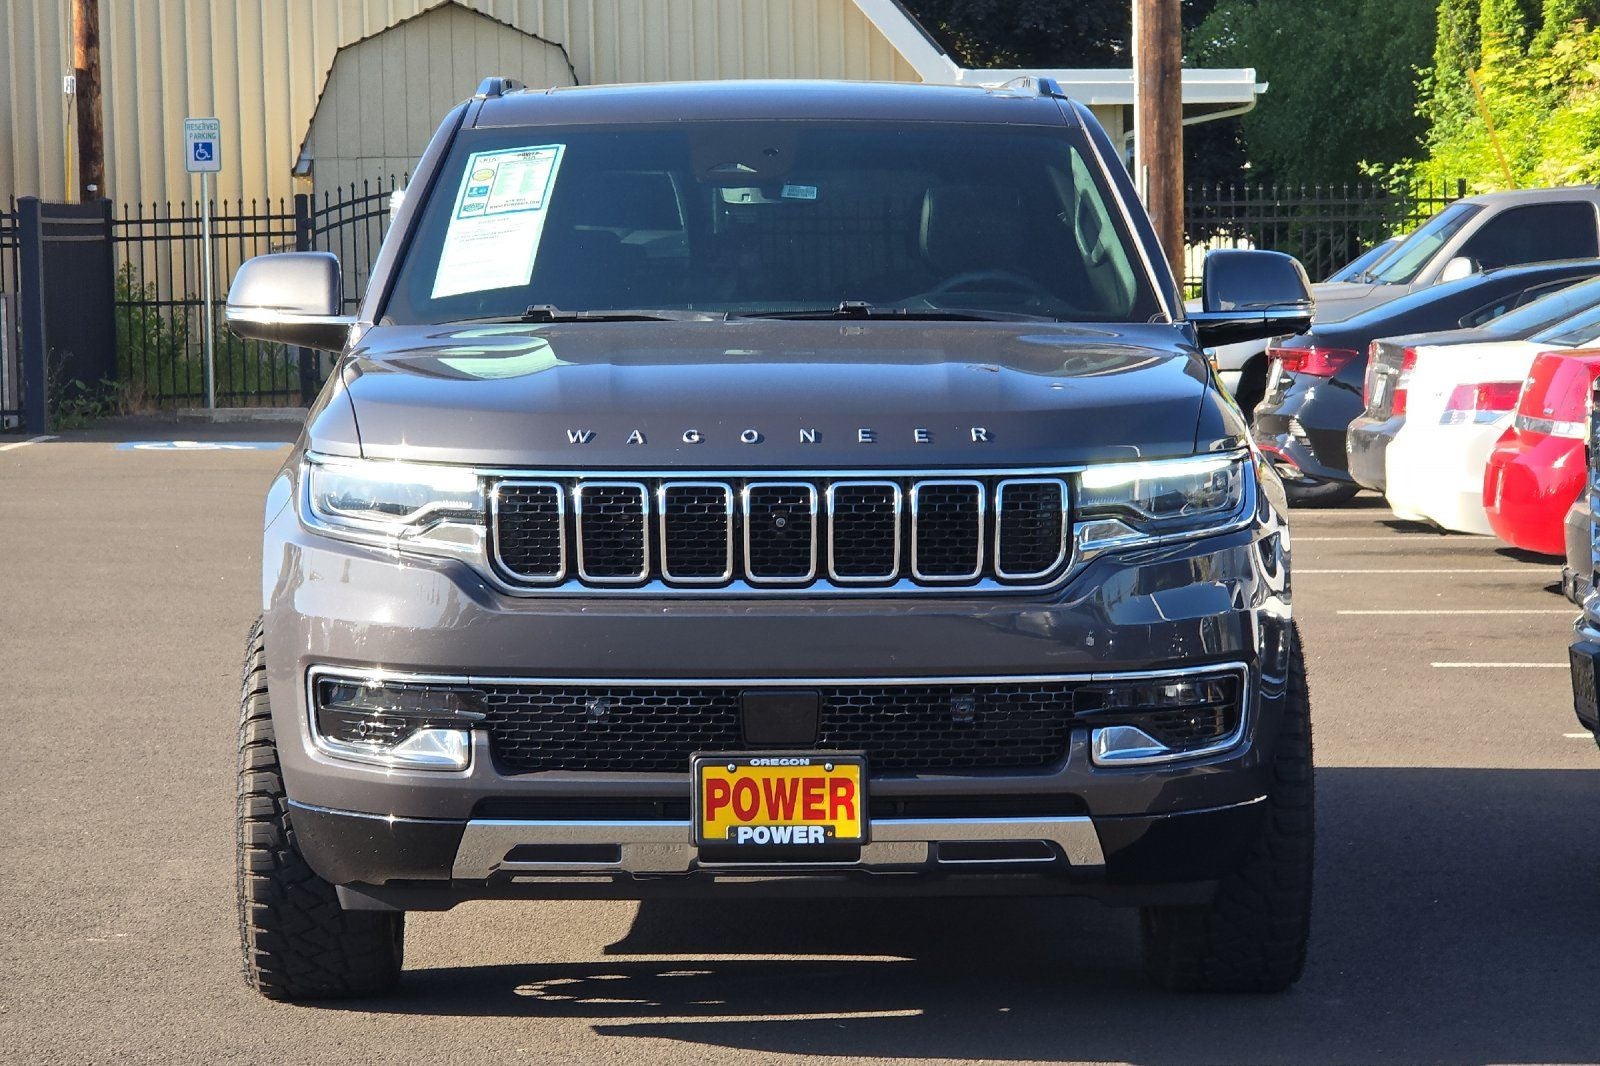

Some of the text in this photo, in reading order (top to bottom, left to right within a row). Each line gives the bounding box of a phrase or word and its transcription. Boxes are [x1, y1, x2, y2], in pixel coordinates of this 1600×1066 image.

[189, 132, 217, 140] PARKING
[567, 427, 988, 444] WAGONEER
[750, 758, 810, 766] OREGON
[705, 776, 856, 822] POWER
[738, 826, 825, 845] POWER
